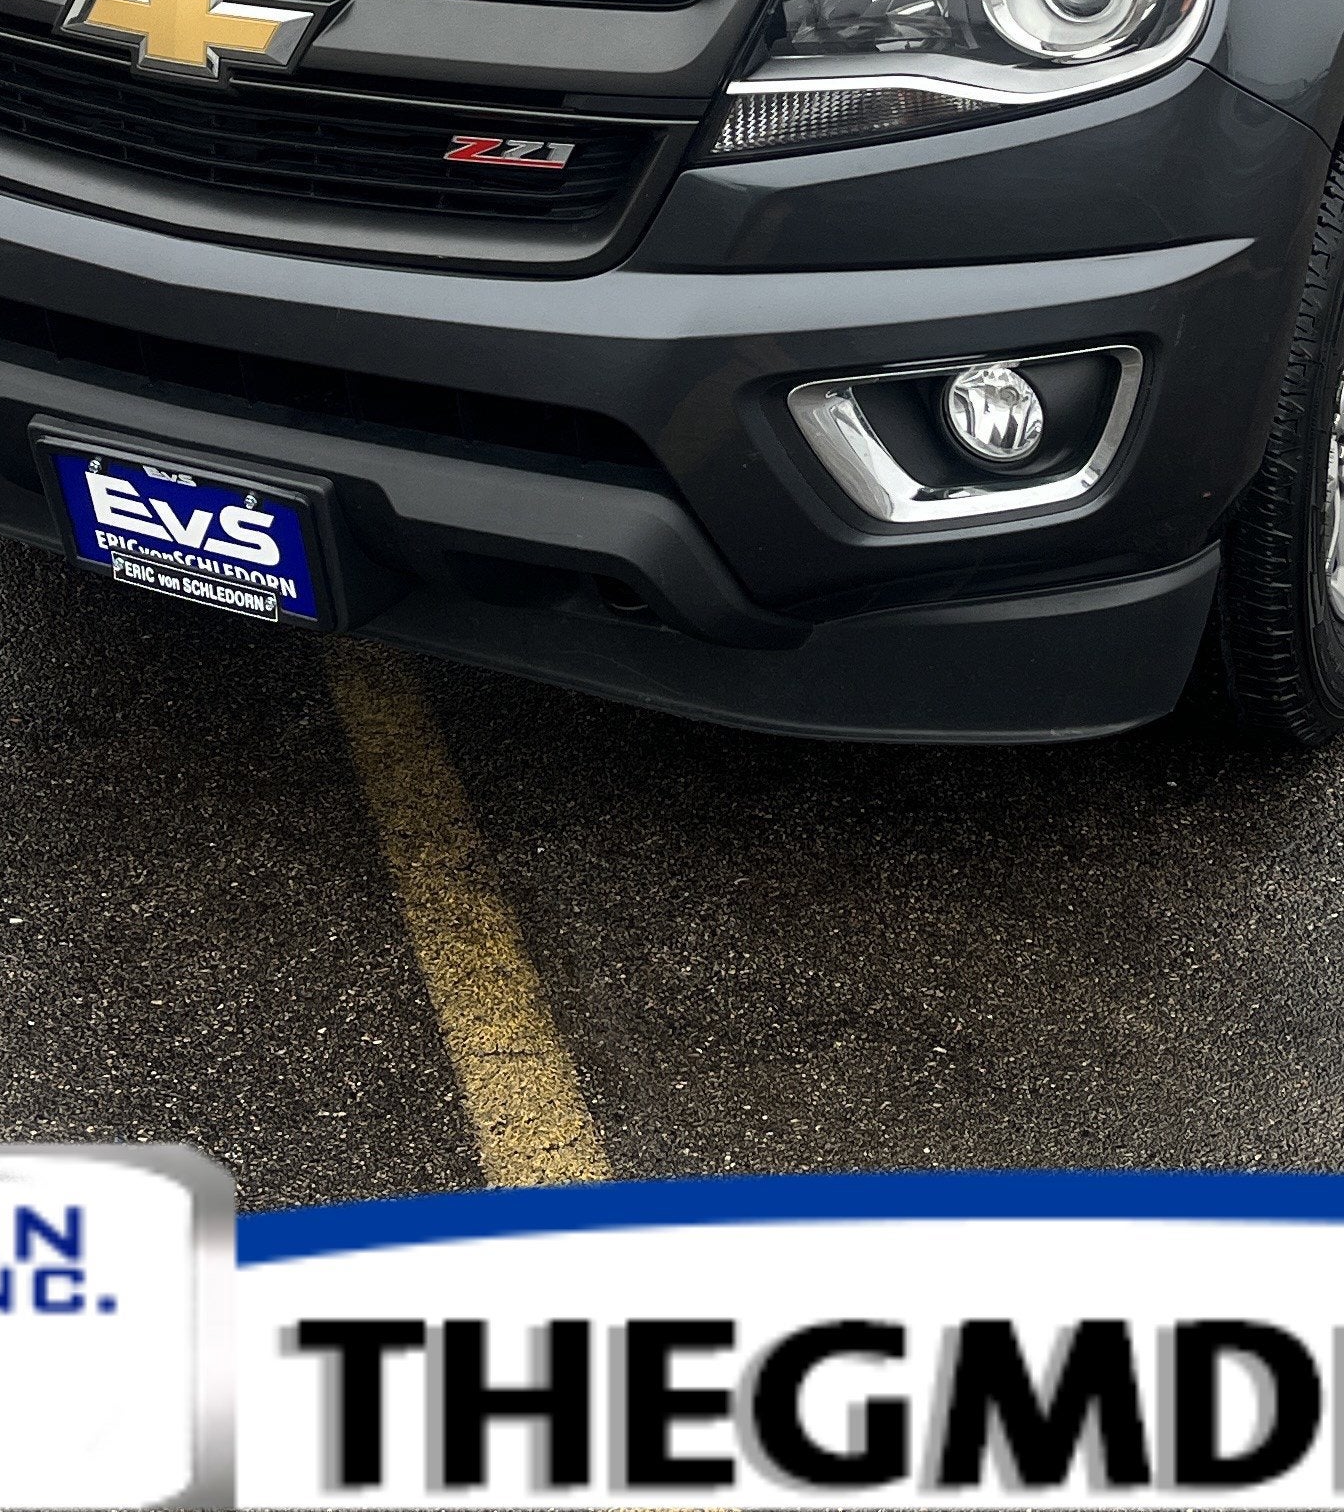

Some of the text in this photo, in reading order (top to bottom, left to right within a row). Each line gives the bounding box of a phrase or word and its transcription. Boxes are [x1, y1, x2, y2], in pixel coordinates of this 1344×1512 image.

[443, 135, 576, 170] Z71
[124, 559, 265, 612] ERIC von SCHLEDORN
